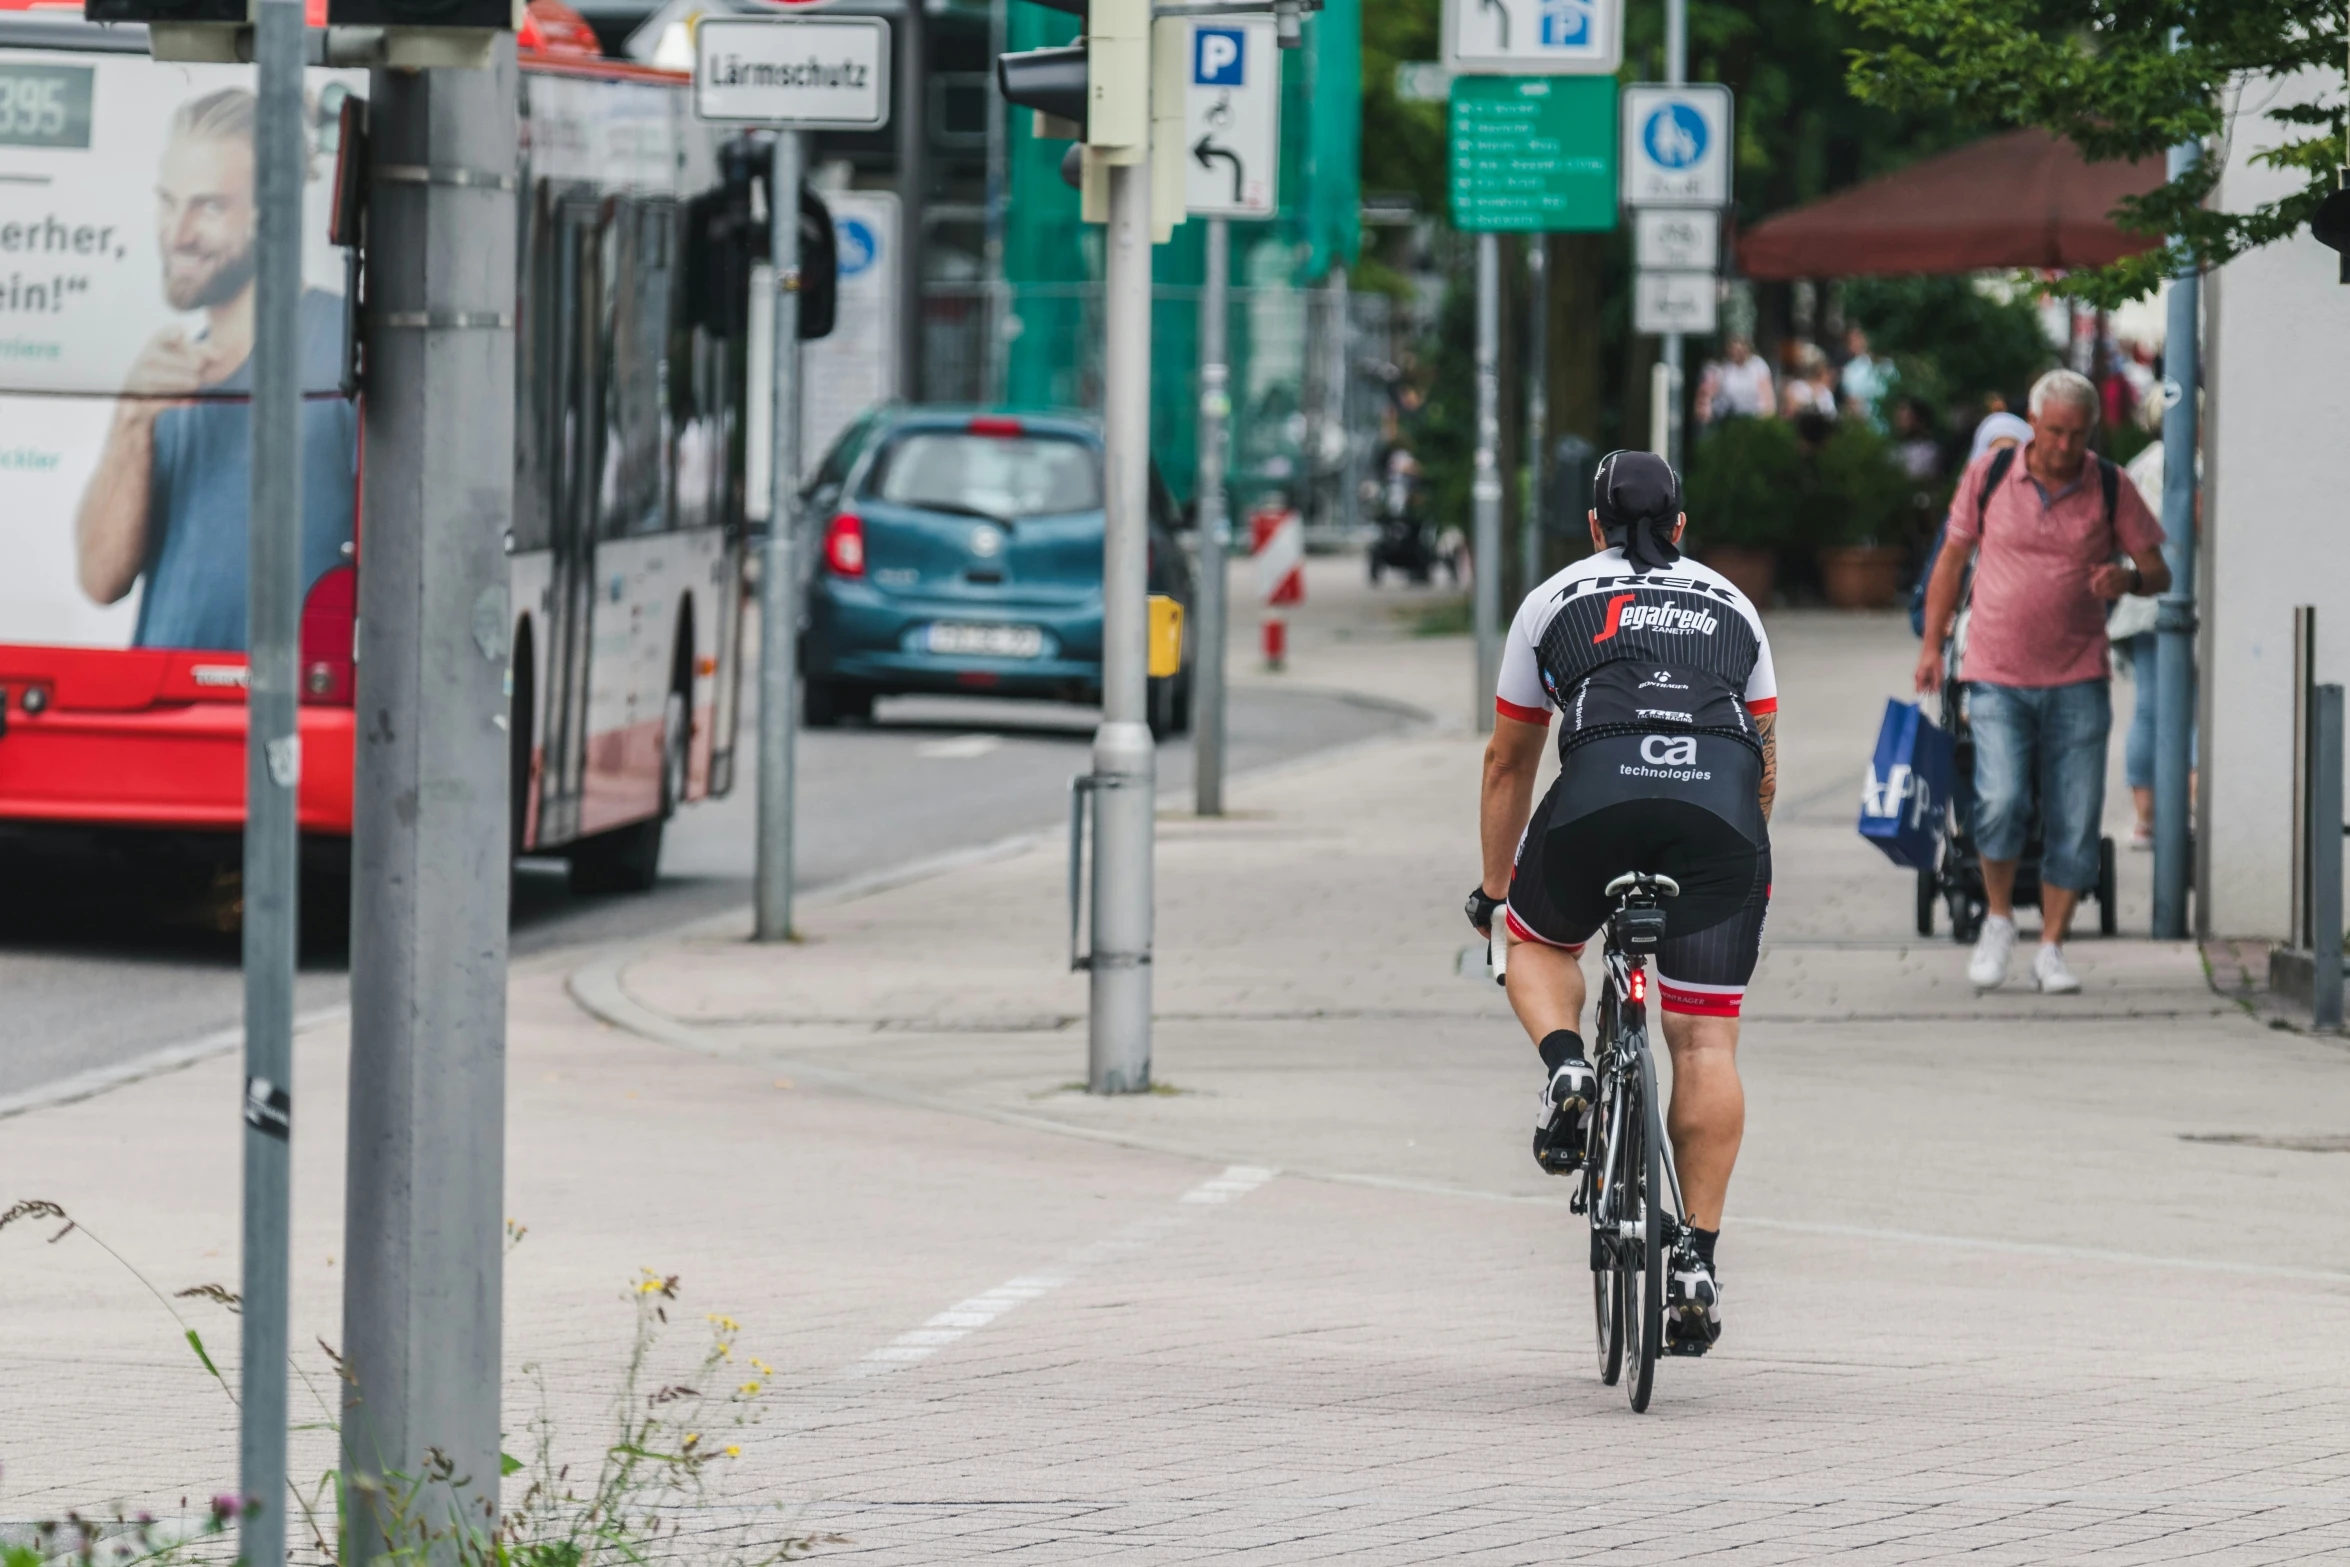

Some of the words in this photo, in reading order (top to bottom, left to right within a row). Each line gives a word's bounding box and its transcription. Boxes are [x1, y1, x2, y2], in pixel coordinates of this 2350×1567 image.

[710, 52, 869, 87] Lärmschutz
[1201, 34, 1238, 79] P
[1550, 575, 1737, 605] TREK
[1593, 594, 1718, 644] Segafredo
[1652, 625, 1695, 635] ZANETTI
[1638, 681, 1689, 689] BONTRAGER
[1635, 709, 1693, 719] TREK
[1640, 735, 1697, 766] ca
[1620, 764, 1711, 782] technologies
